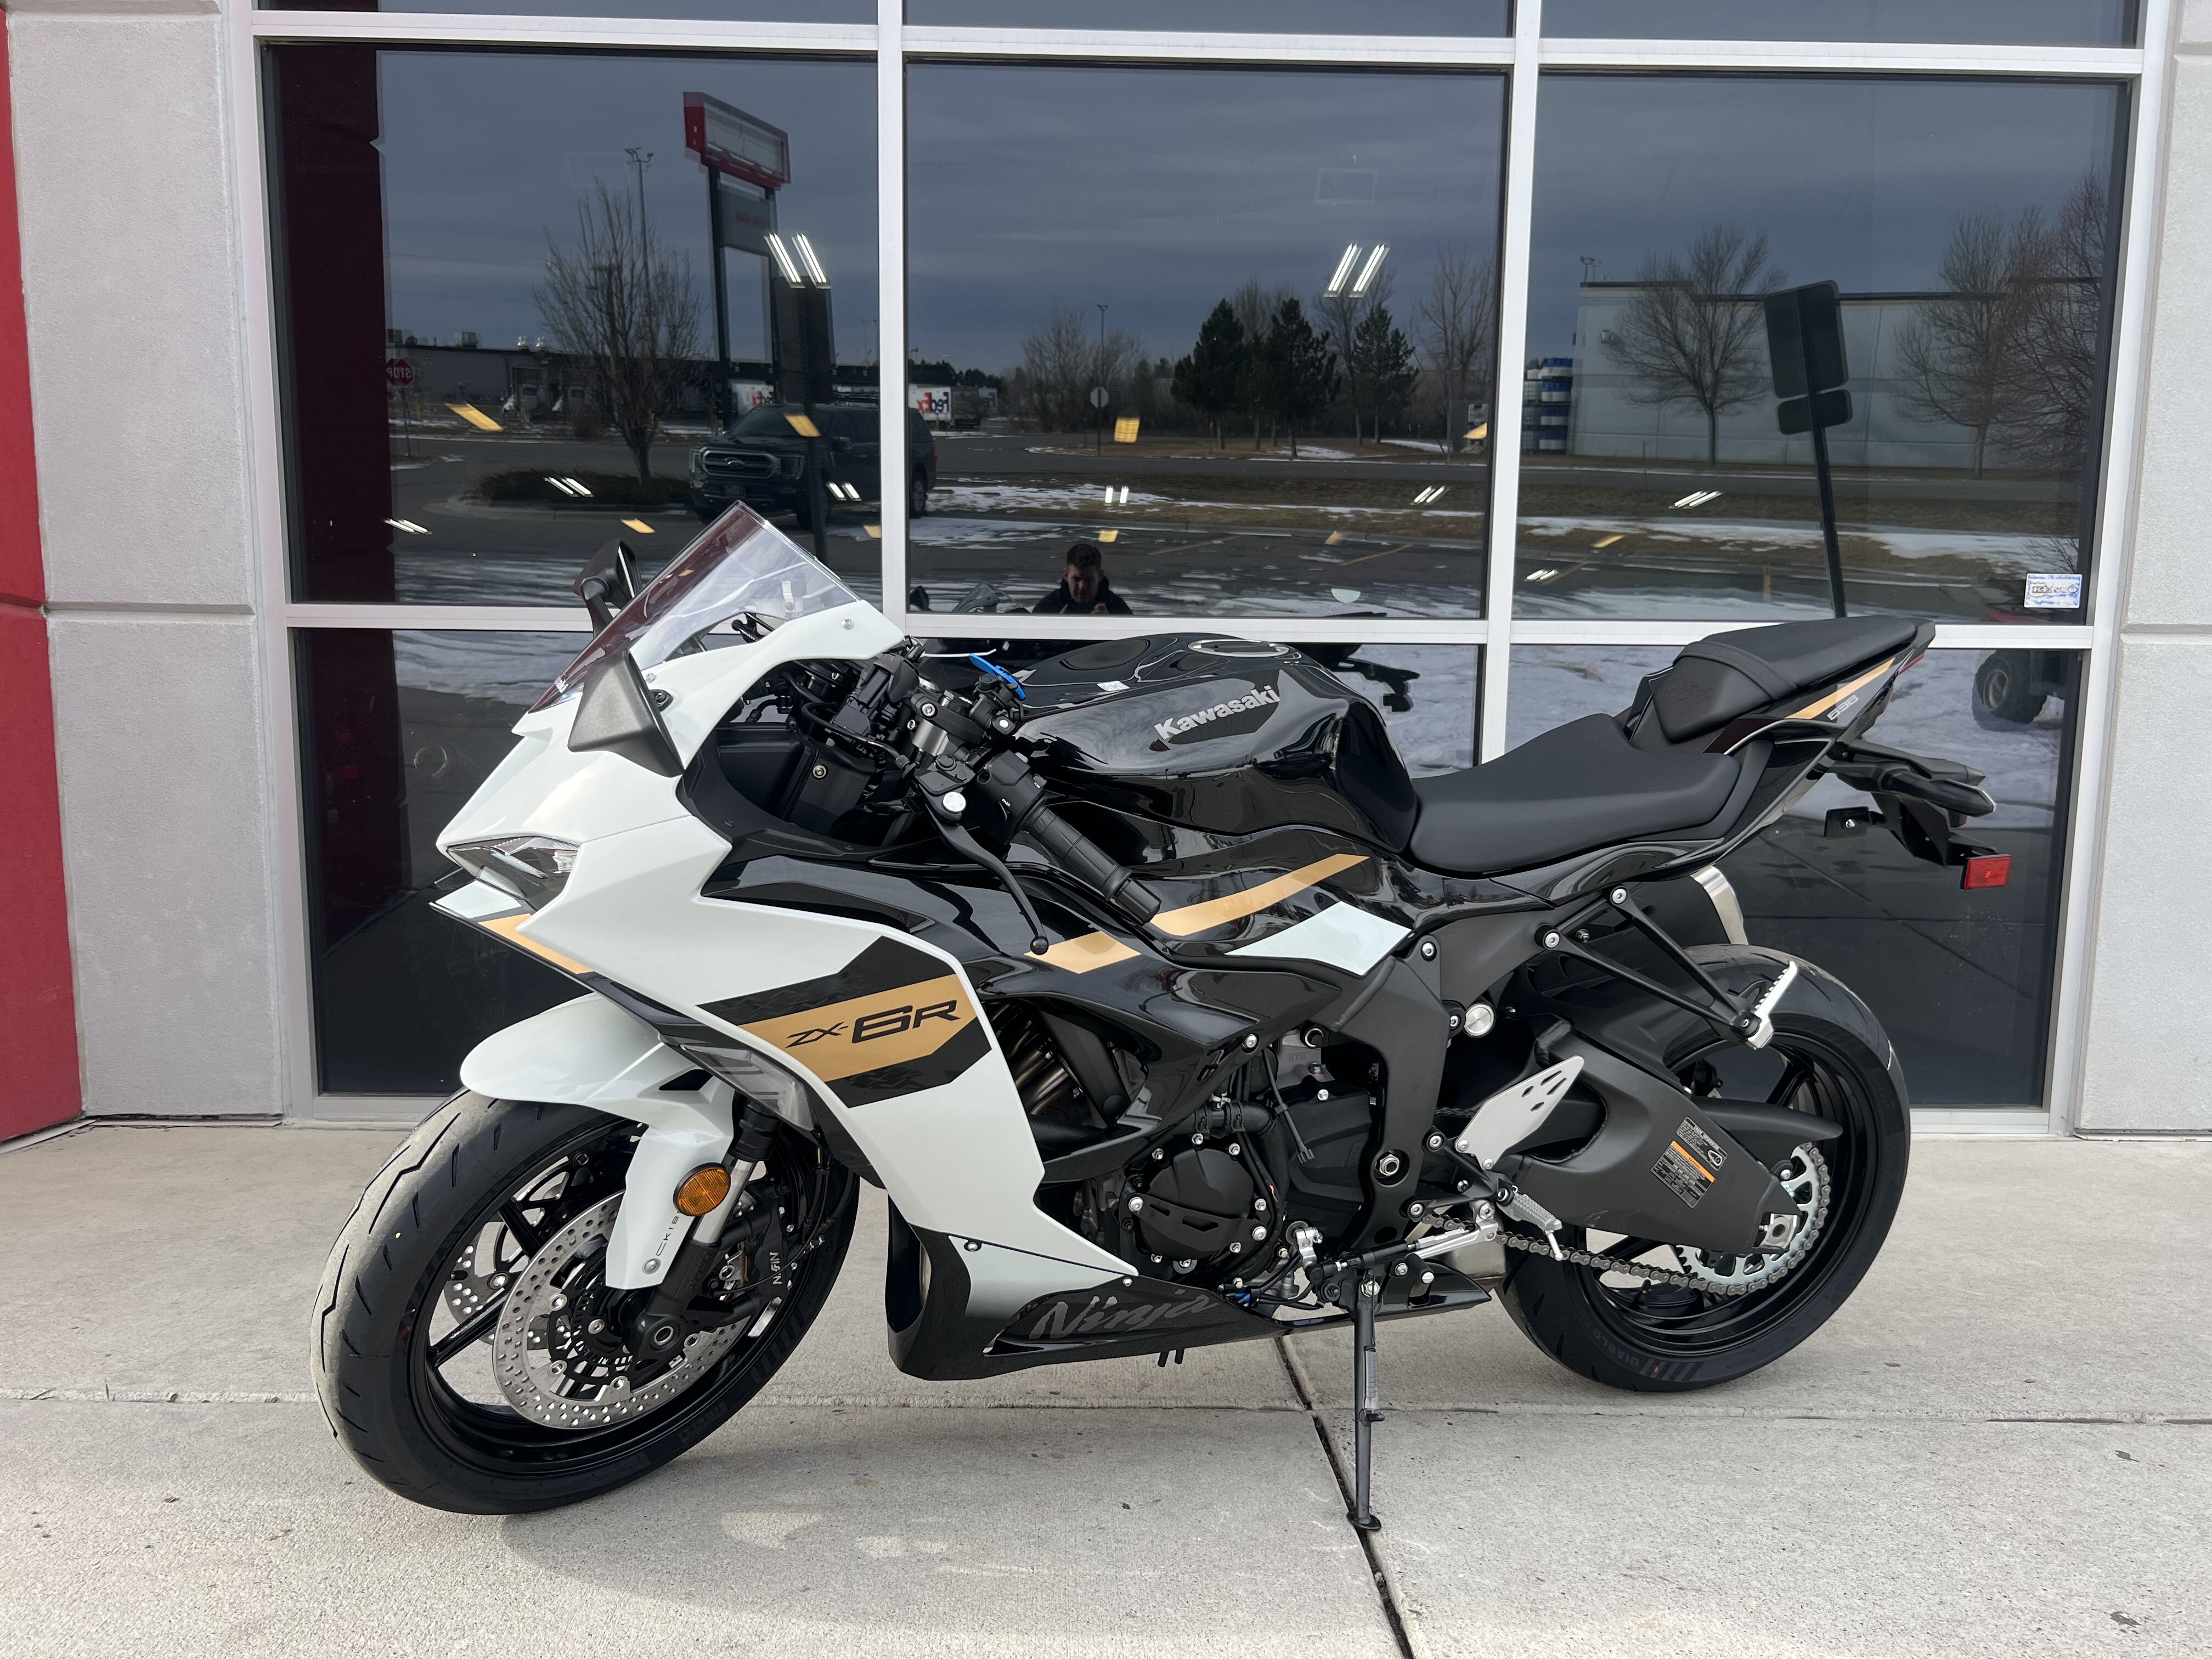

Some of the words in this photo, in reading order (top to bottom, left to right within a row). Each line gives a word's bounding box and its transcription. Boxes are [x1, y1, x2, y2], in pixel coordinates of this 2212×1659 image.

[1154, 685, 1282, 740] Kawasaki
[1827, 694, 1859, 721] 636
[1001, 798, 1011, 807] PASS
[785, 1000, 961, 1048] ZX-6R
[1029, 1288, 1218, 1339] Ninja
